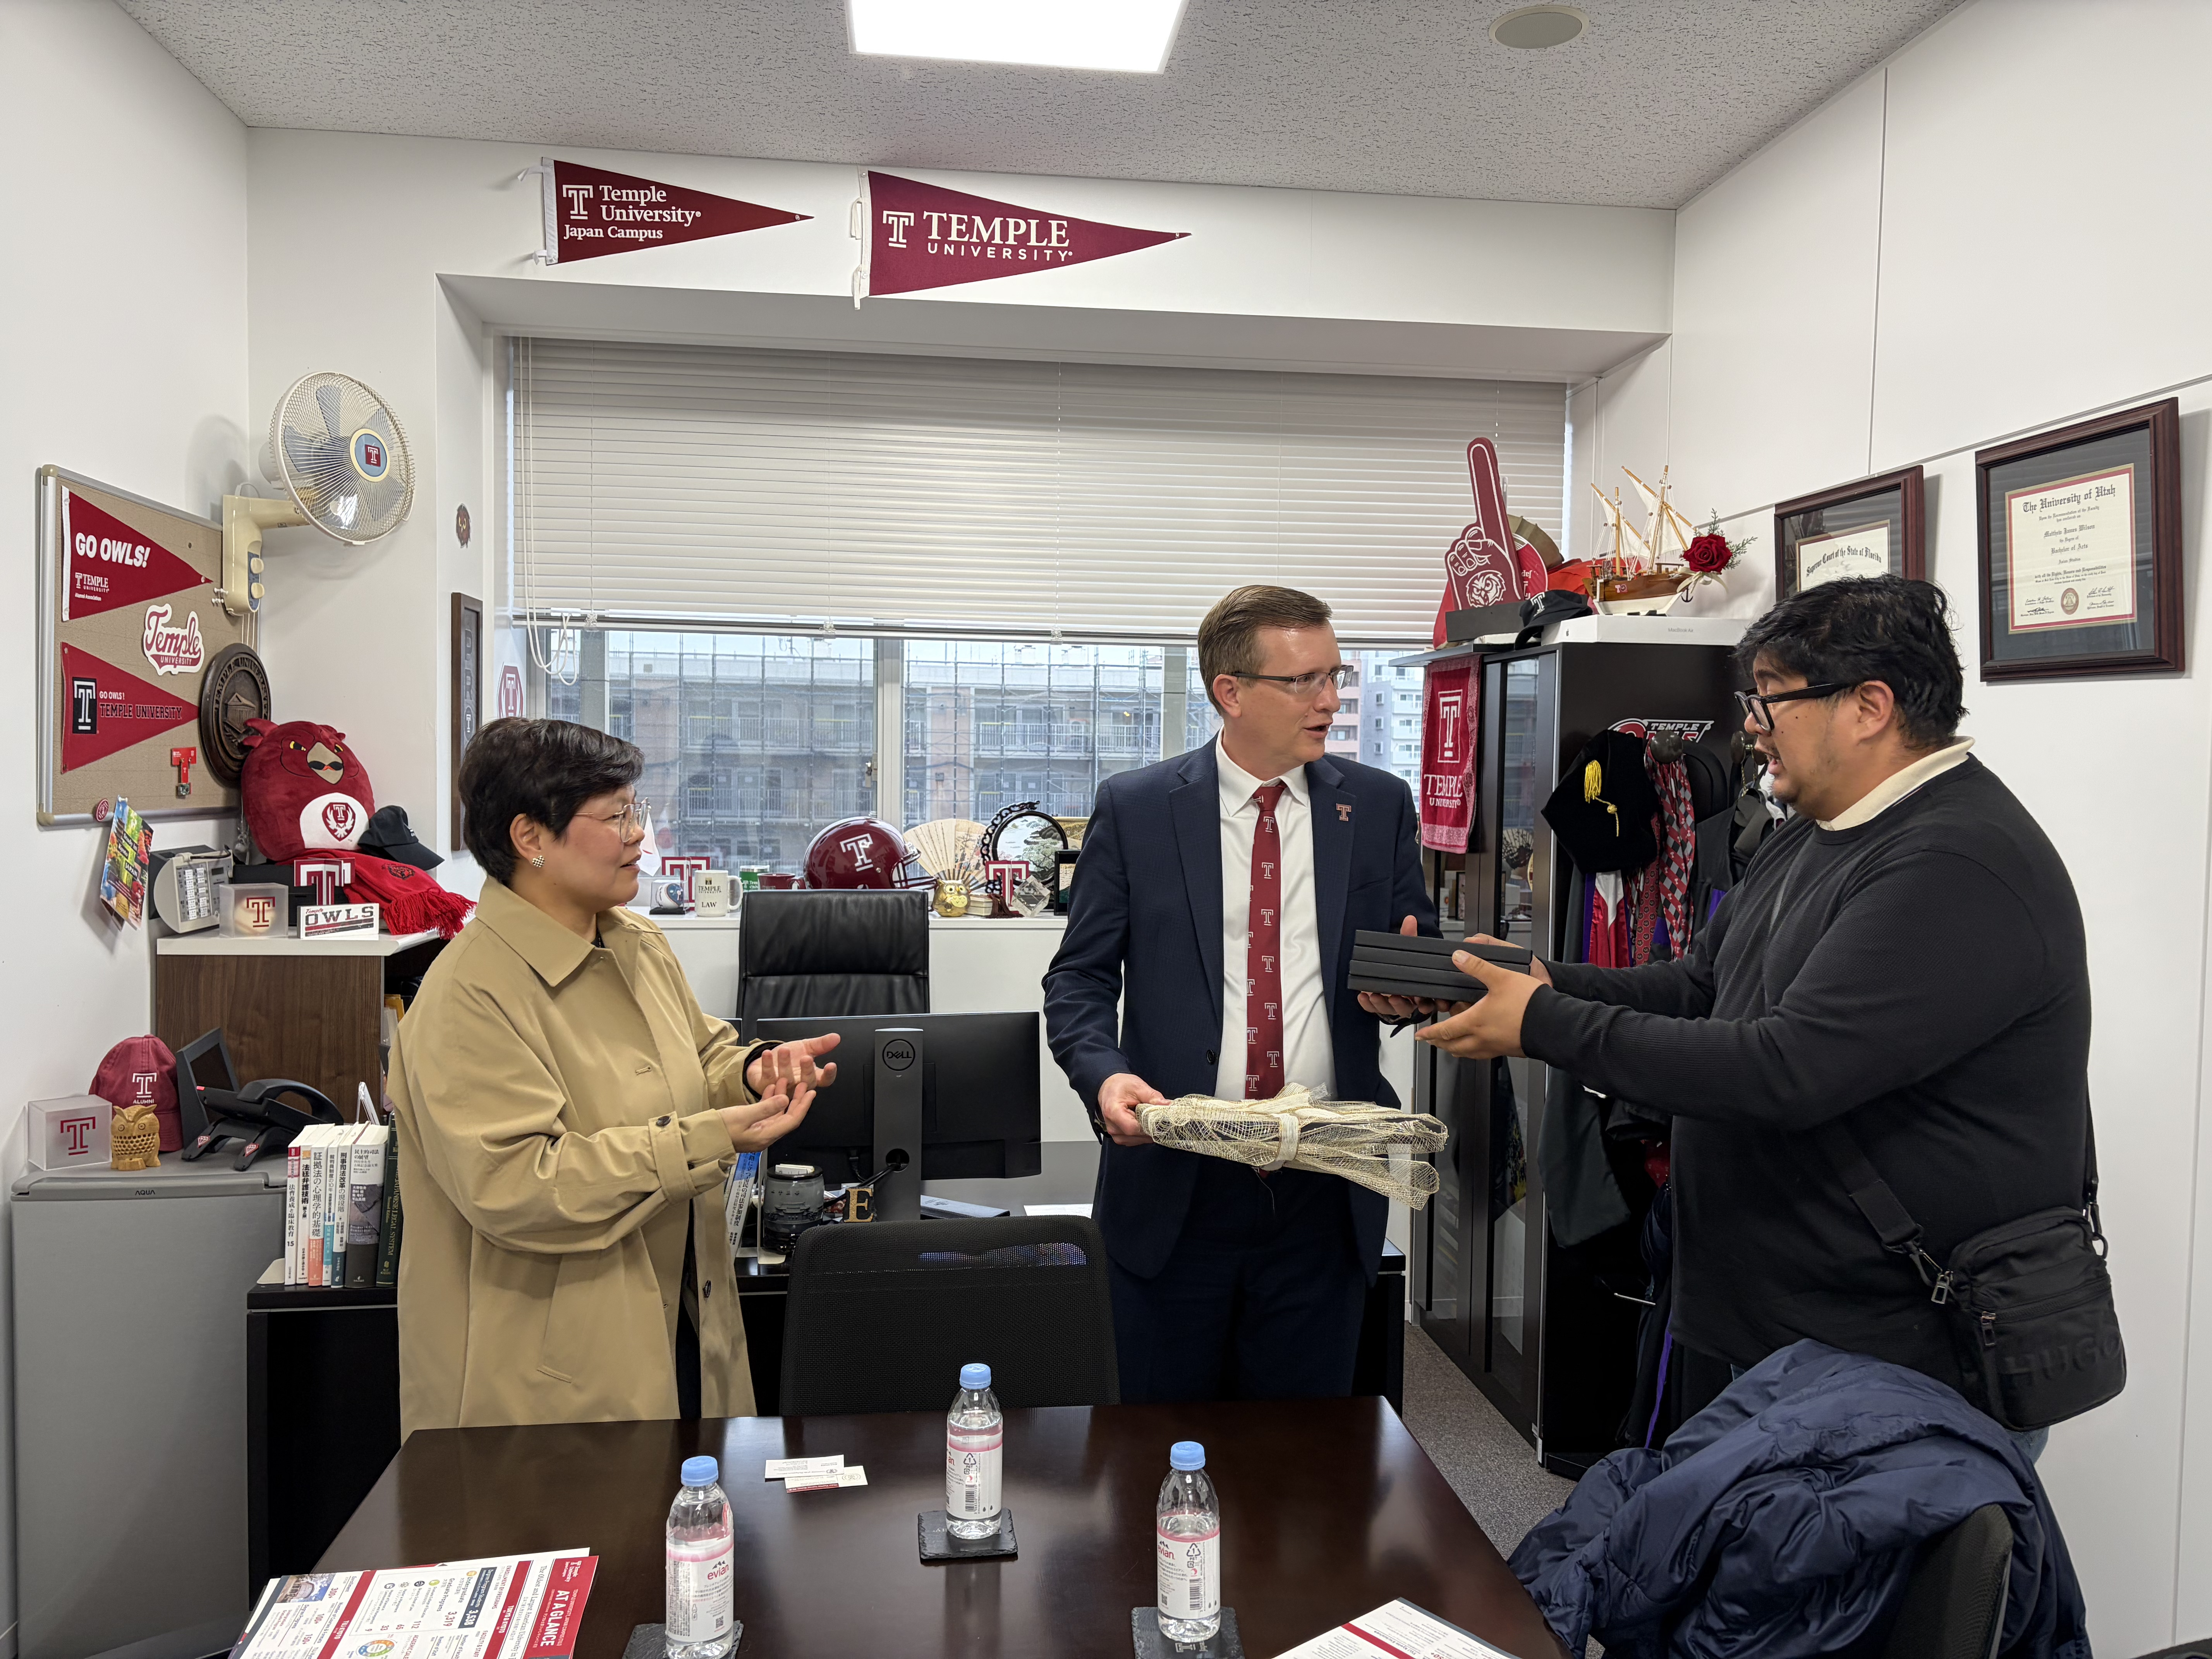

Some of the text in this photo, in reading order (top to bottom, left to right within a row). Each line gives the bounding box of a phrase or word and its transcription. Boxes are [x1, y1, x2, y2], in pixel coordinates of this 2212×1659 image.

[599, 185, 666, 206] Temple
[563, 225, 663, 241] Japan Campus
[923, 211, 1069, 247] TEMPLE
[2023, 484, 2116, 514] The University of Utah
[2044, 530, 2062, 539] Matthew
[76, 532, 151, 568] GO OWLS!
[2051, 546, 2070, 555] Bachelor
[1806, 559, 1822, 577] Supreme
[1822, 551, 1834, 564] Court
[1835, 549, 1839, 558] of
[1847, 546, 1858, 555] State
[1860, 547, 1863, 555] of
[1865, 547, 1881, 563] Florida
[83, 574, 108, 588] TEMPLE
[145, 610, 201, 668] Temple
[160, 656, 192, 665] UNIVERSITY
[100, 691, 107, 699] GO
[100, 702, 182, 720] TEMPLE UNIVERSITY
[1424, 774, 1463, 797] TEMPLE
[125, 862, 137, 877] JAPAN
[305, 906, 374, 926] OWLS
[886, 1051, 912, 1059] DELL
[302, 1164, 310, 1204] 法廷弁護技術
[338, 1152, 347, 1212] 刑事司法改革の現段階
[312, 1152, 323, 1237] 証拠法の心理学的基礎
[844, 1188, 874, 1223] E
[1158, 1545, 1175, 1560] evian
[501, 1566, 512, 1586] ENROLLMENT
[708, 1564, 729, 1580] evian
[345, 1576, 357, 1592] Enrollment
[475, 1570, 494, 1607] Degree Program Students
[535, 1574, 544, 1587] Oldest
[328, 1588, 338, 1599] 300+
[437, 1578, 455, 1611] Graduate Programs
[458, 1577, 473, 1603] Undergraduate
[555, 1590, 570, 1601] AT
[335, 1602, 343, 1614] Number
[492, 1591, 503, 1609] PROGRAMS
[527, 1597, 538, 1611] Largest
[292, 1605, 309, 1629] Degree Programs
[314, 1614, 325, 1624] 100+
[443, 1612, 457, 1626] 3,319
[464, 1609, 479, 1626] 3,538
[505, 1605, 514, 1618] TOKYO
[498, 1620, 508, 1633] KYOTO
[520, 1612, 531, 1631] American
[540, 1611, 564, 1647] GLANCE
[302, 1634, 313, 1644] 150+
[334, 1627, 345, 1639] KYOTO
[478, 1630, 489, 1644] FACULTY
[407, 1635, 419, 1650] ACADEMIC
[511, 1631, 526, 1652] University
[473, 1648, 481, 1657] STAFF
